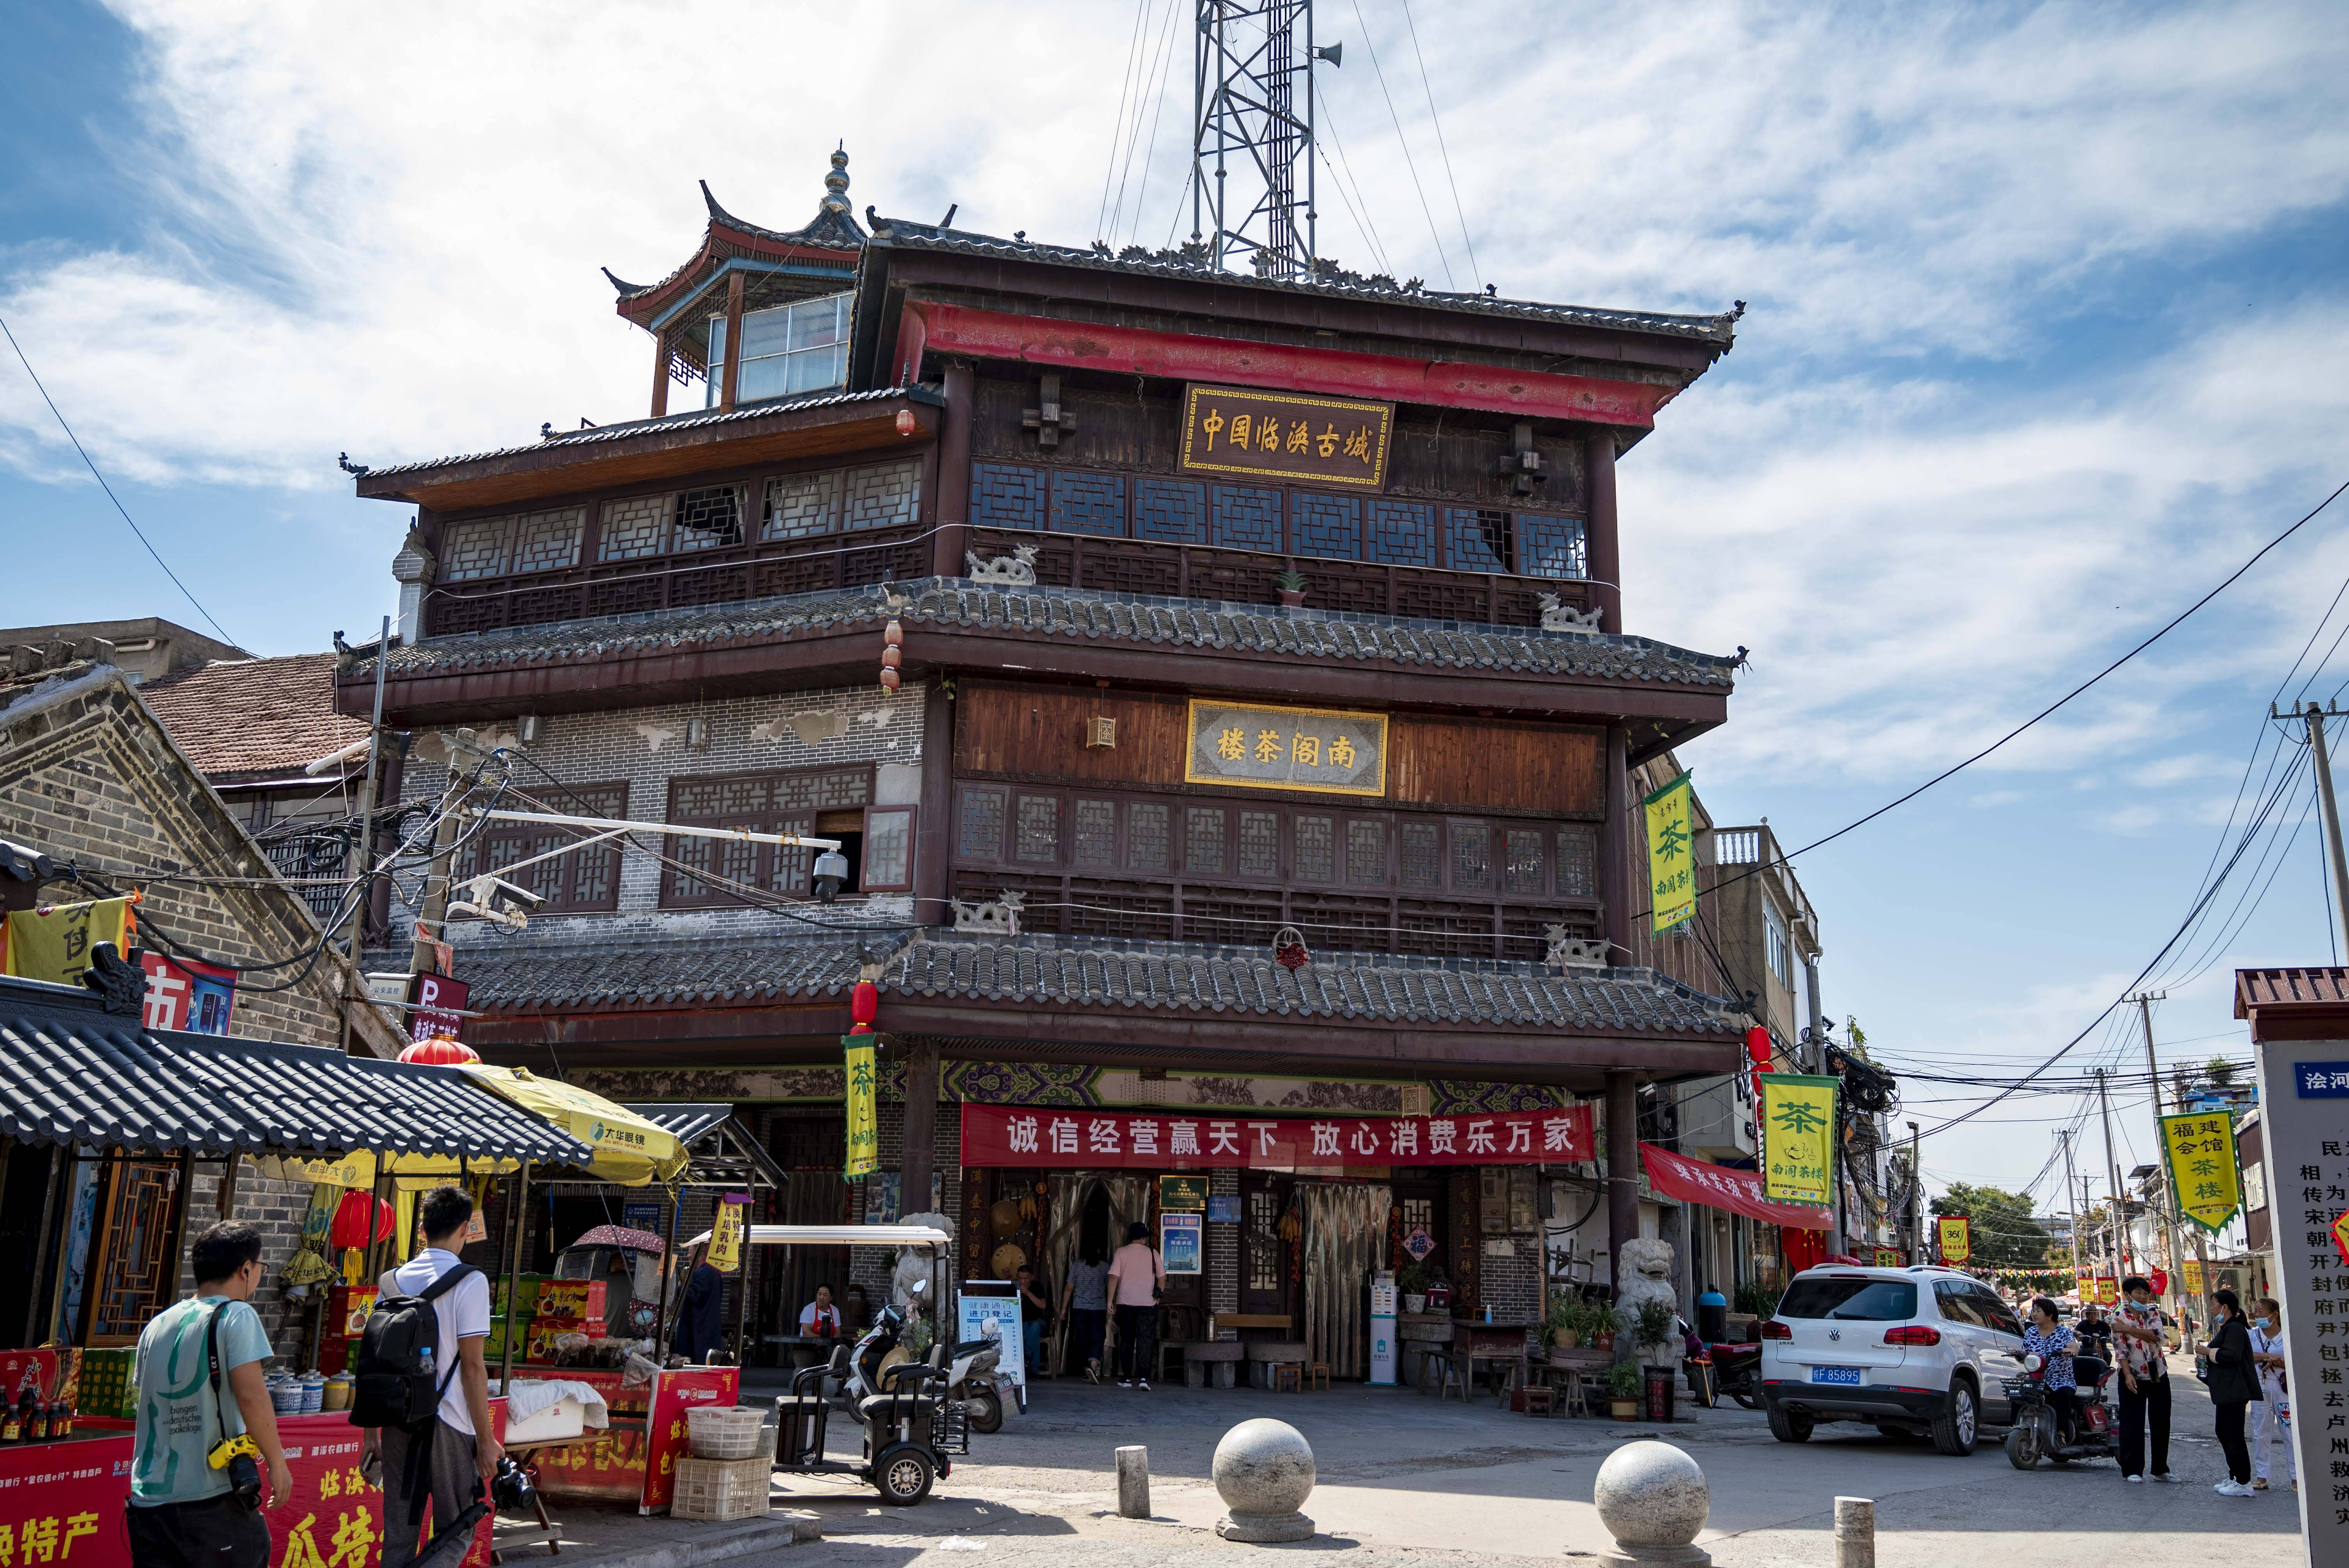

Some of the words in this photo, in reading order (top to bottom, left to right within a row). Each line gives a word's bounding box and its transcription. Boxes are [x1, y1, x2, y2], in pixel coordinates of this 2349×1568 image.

[1203, 408, 1372, 465] 中国临涣古城
[1660, 798, 1677, 817] 老字号
[1655, 819, 1688, 863] 茶
[144, 966, 185, 1028] 市
[421, 979, 438, 1007] P
[852, 1060, 874, 1096] 茶
[1772, 1101, 1828, 1134] 茶
[2173, 1120, 2222, 1138] 福建
[605, 1128, 645, 1146] 大华眼镜
[1007, 1115, 1278, 1156] 诚信经营赢天下
[1310, 1116, 1574, 1156] 放心消费乐万家
[2175, 1138, 2223, 1155] 会馆
[1771, 1163, 1824, 1180] 南阁茶楼
[2190, 1158, 2223, 1200] 茶楼
[732, 1204, 741, 1243] 涣特产
[1410, 1235, 1428, 1253] 福
[549, 1291, 578, 1303] 培乳肉
[171, 1405, 198, 1415] bungen
[169, 1423, 202, 1435] exikologie
